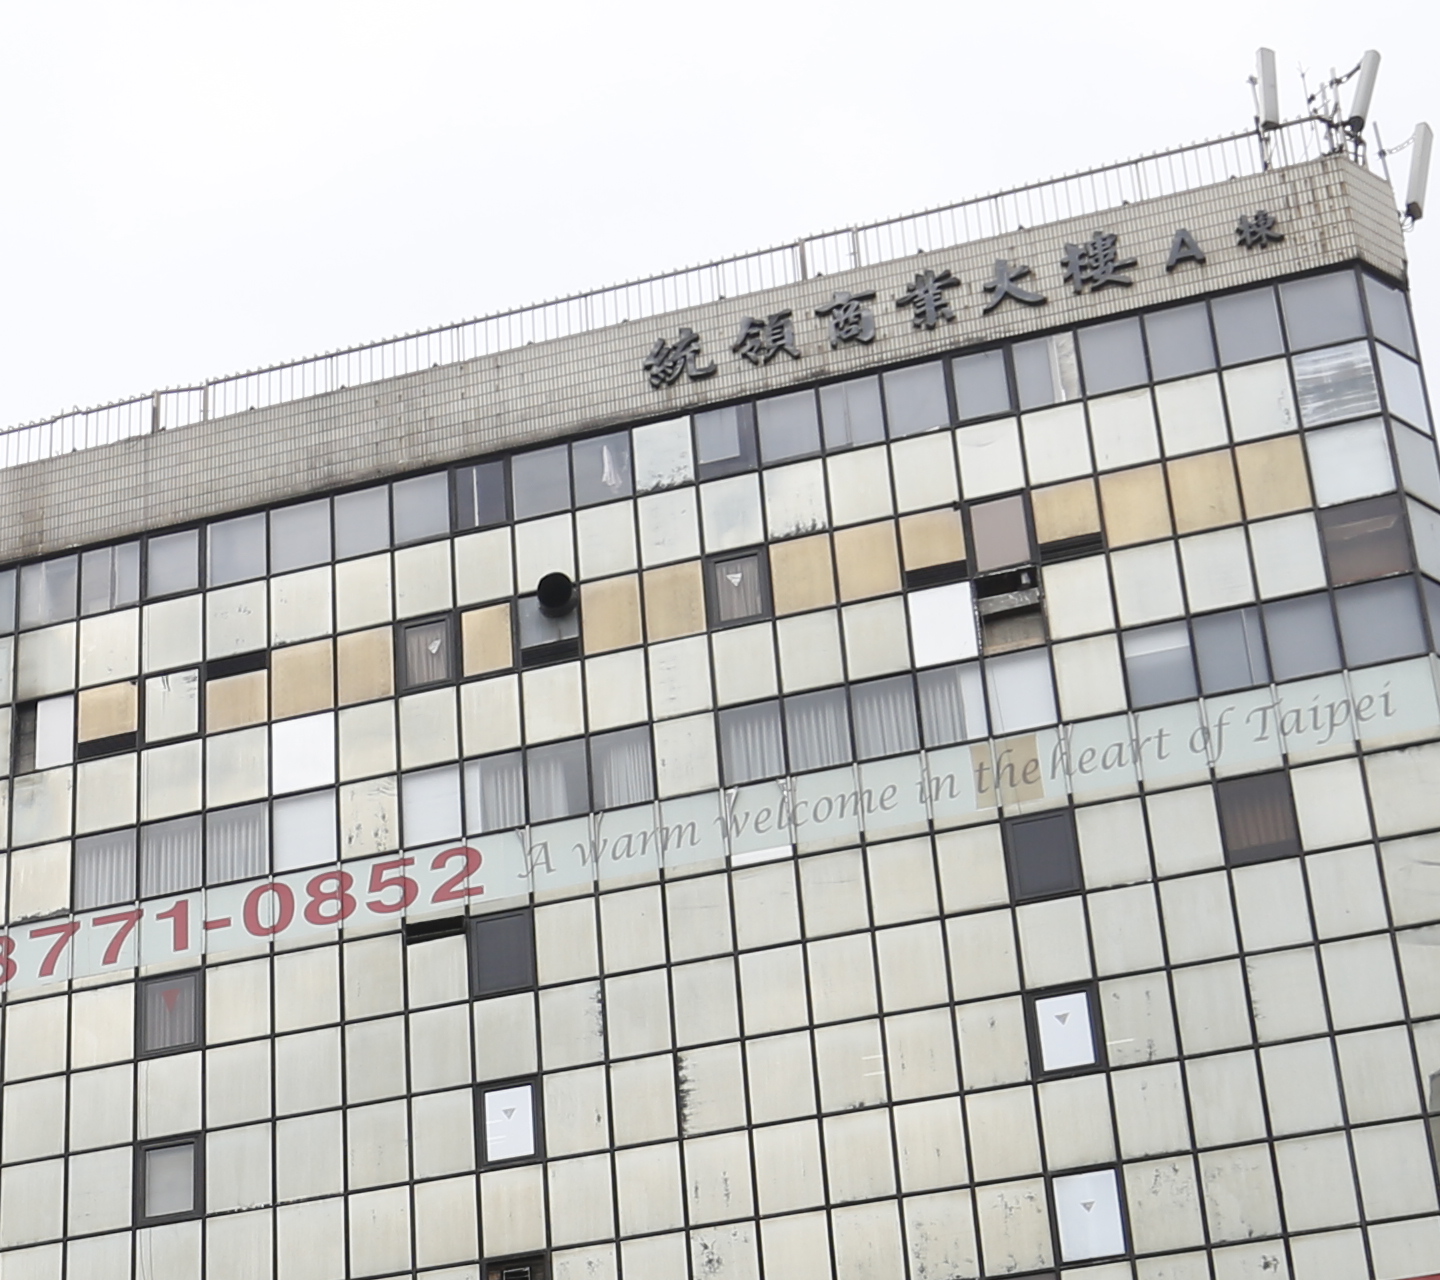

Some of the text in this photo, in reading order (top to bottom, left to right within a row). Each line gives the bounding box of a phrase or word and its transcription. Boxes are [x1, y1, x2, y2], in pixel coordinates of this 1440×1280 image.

[518, 680, 1398, 879] A warm welcome in the heart of Taipei
